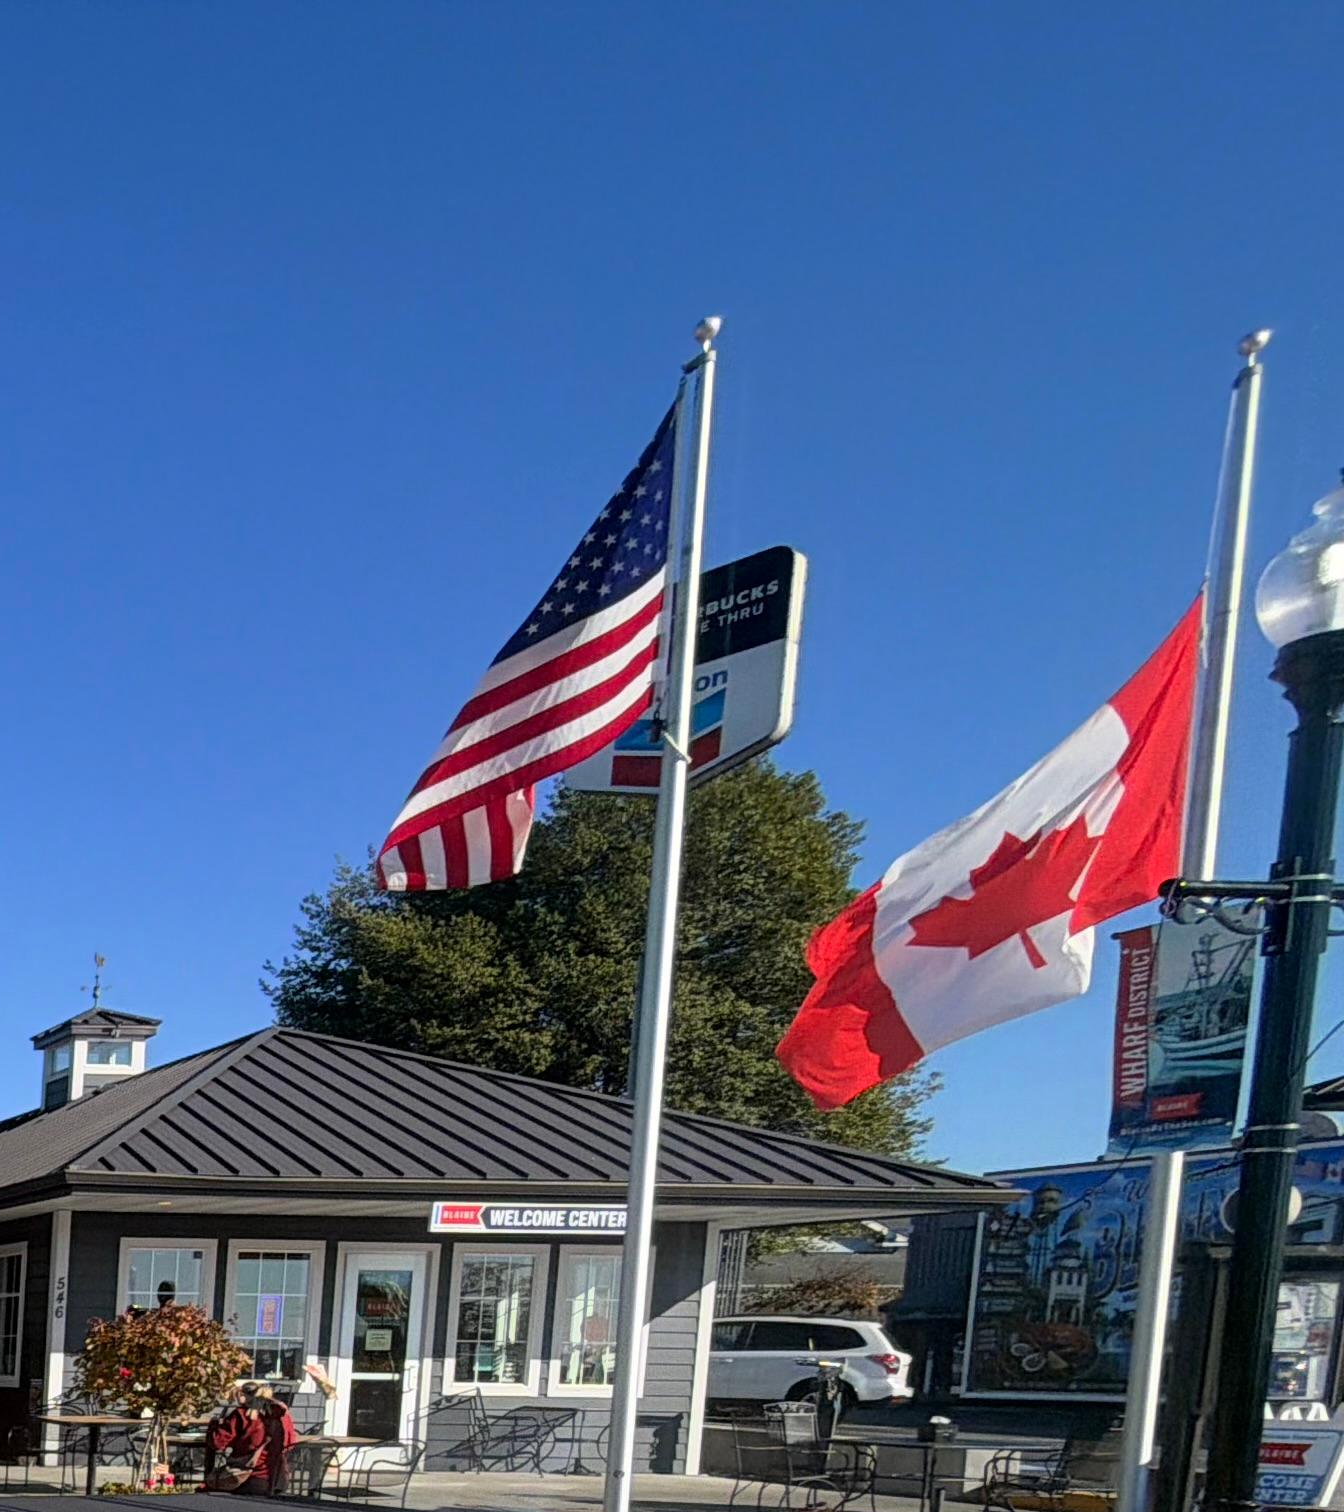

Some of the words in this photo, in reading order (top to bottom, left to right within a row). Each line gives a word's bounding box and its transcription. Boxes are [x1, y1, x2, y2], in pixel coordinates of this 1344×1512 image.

[718, 602, 764, 627] THRU
[1128, 947, 1150, 1019] DISTRICT
[1120, 1022, 1148, 1098] WHARF
[489, 1209, 565, 1227] WELCOME
[568, 1210, 627, 1228] CENTER
[55, 1276, 65, 1319] 546
[1259, 1475, 1315, 1489] COME
[1255, 1488, 1308, 1503] NTER
